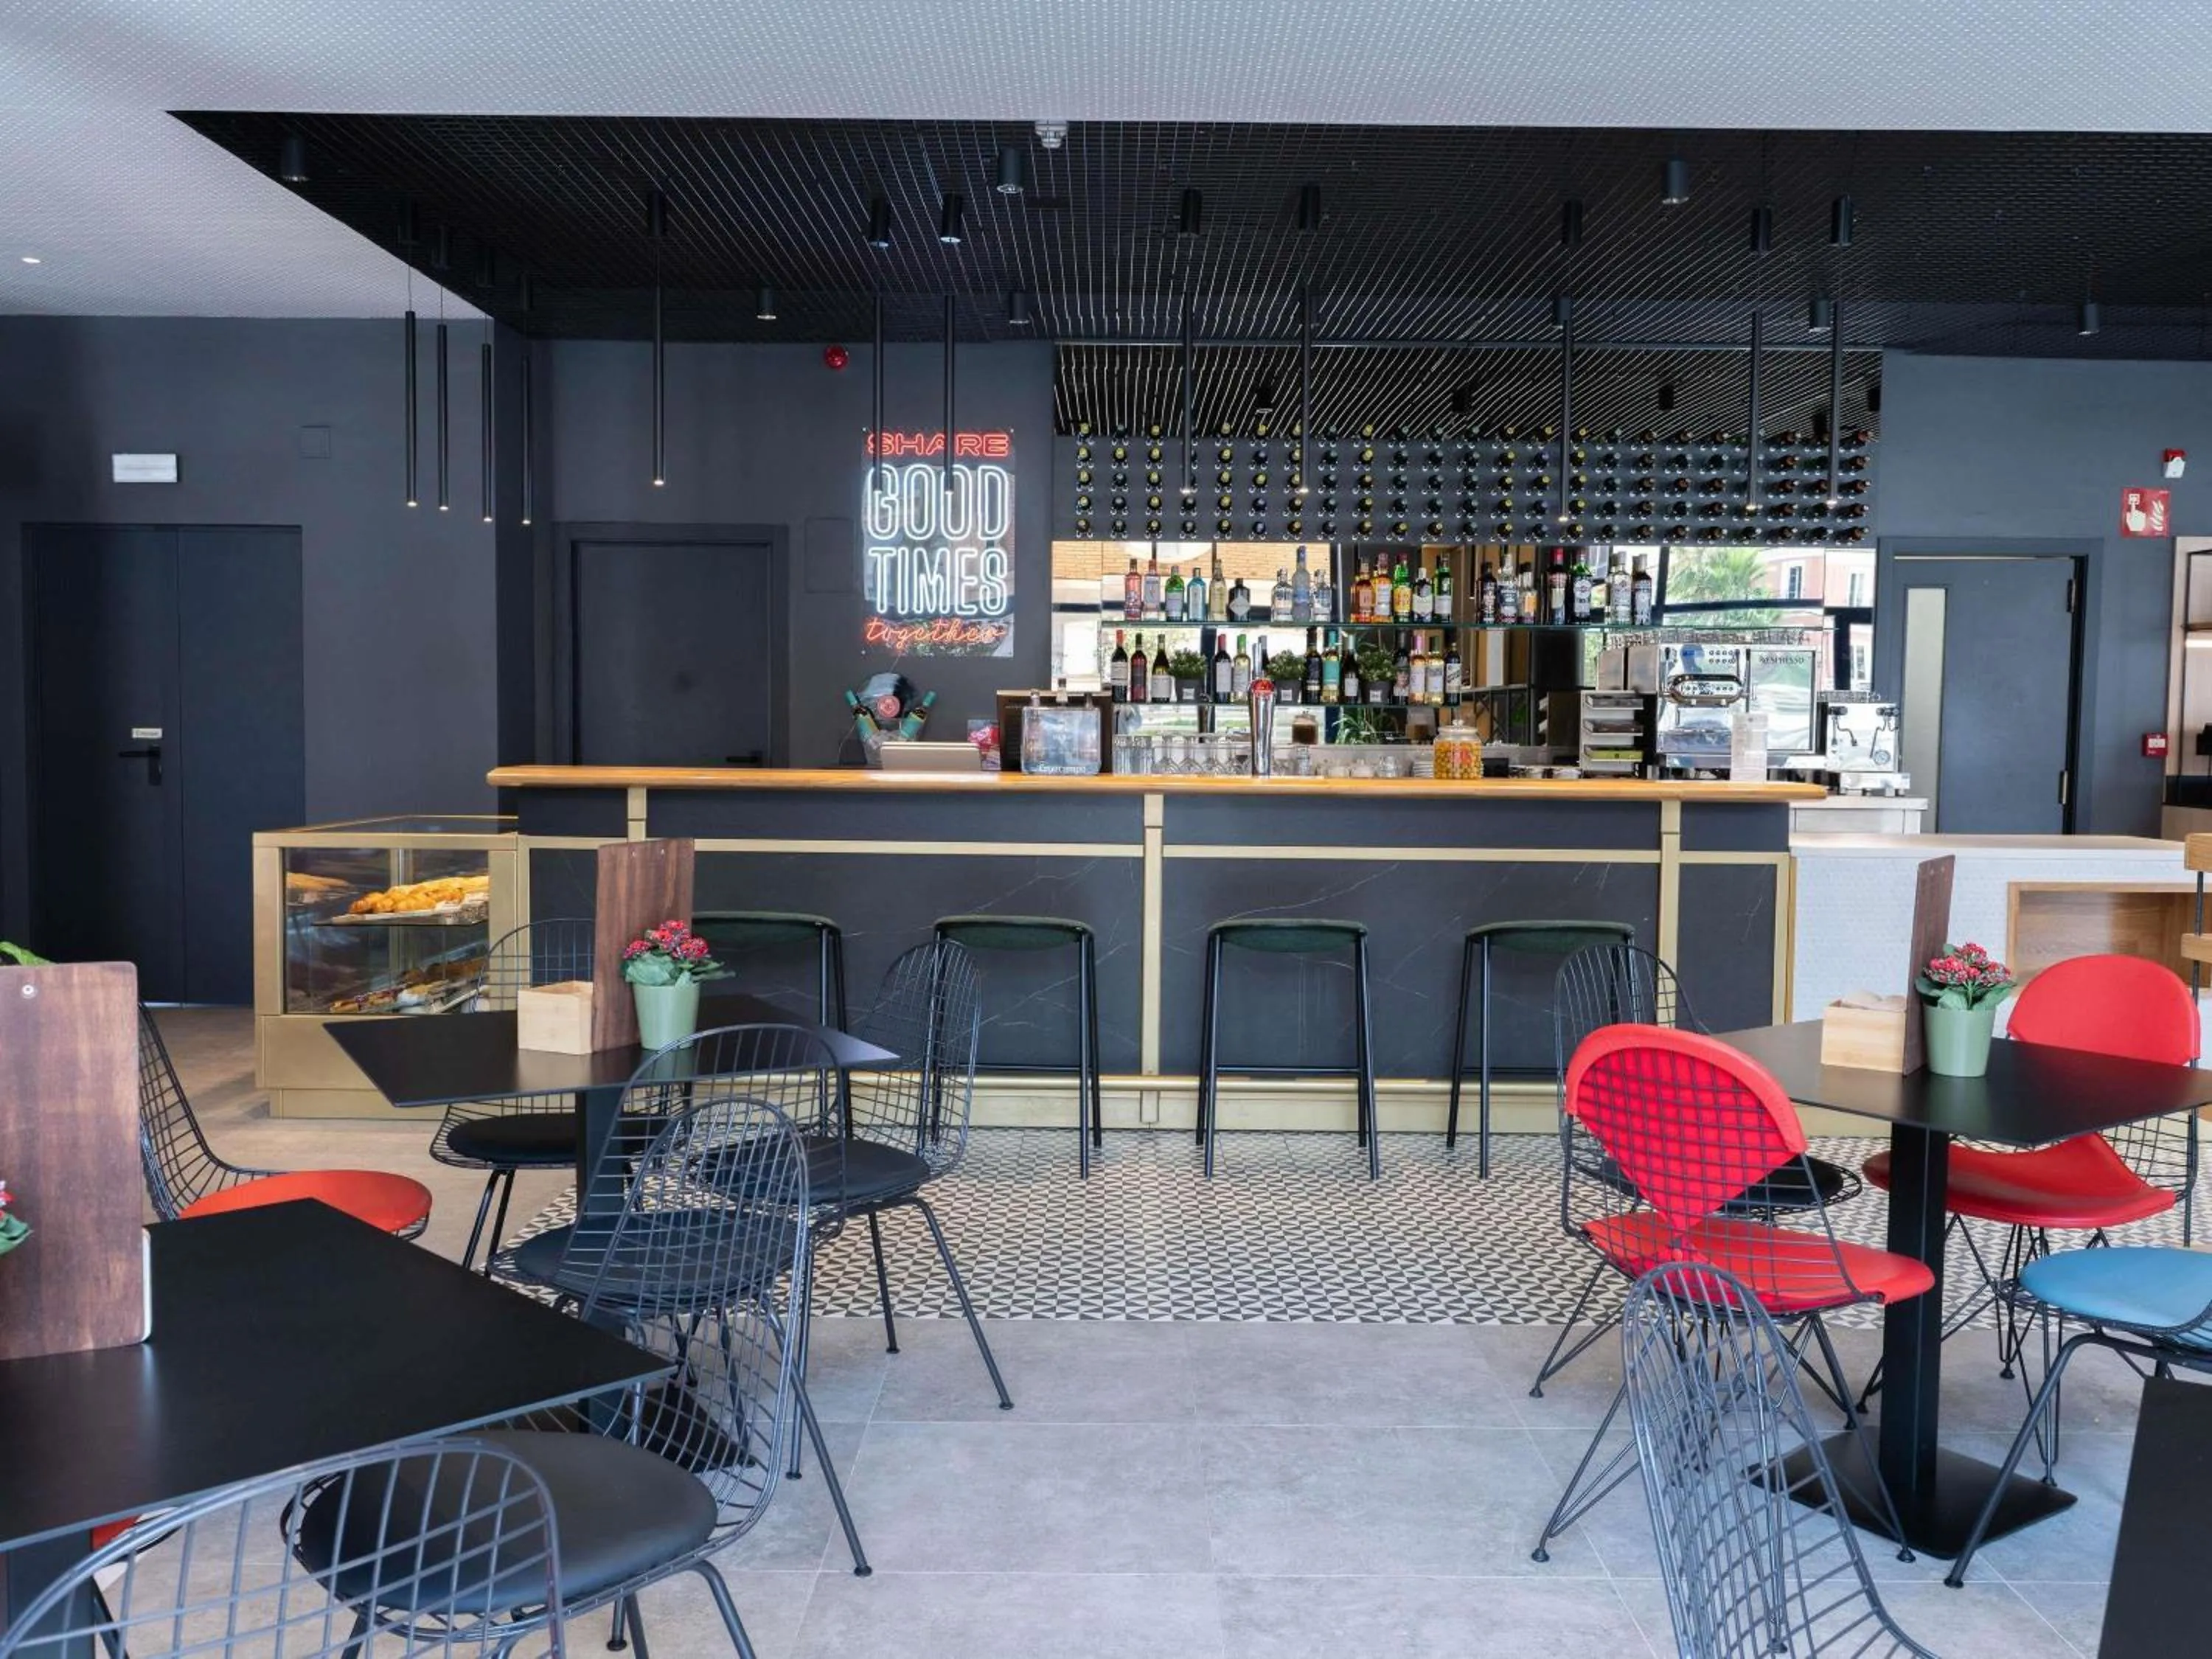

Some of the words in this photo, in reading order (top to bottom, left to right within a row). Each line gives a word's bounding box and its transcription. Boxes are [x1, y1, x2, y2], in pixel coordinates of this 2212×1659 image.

[868, 434, 1009, 457] SHARE
[867, 464, 1009, 540] GOOD
[869, 547, 1009, 615] TIMES
[866, 617, 1008, 650] together
